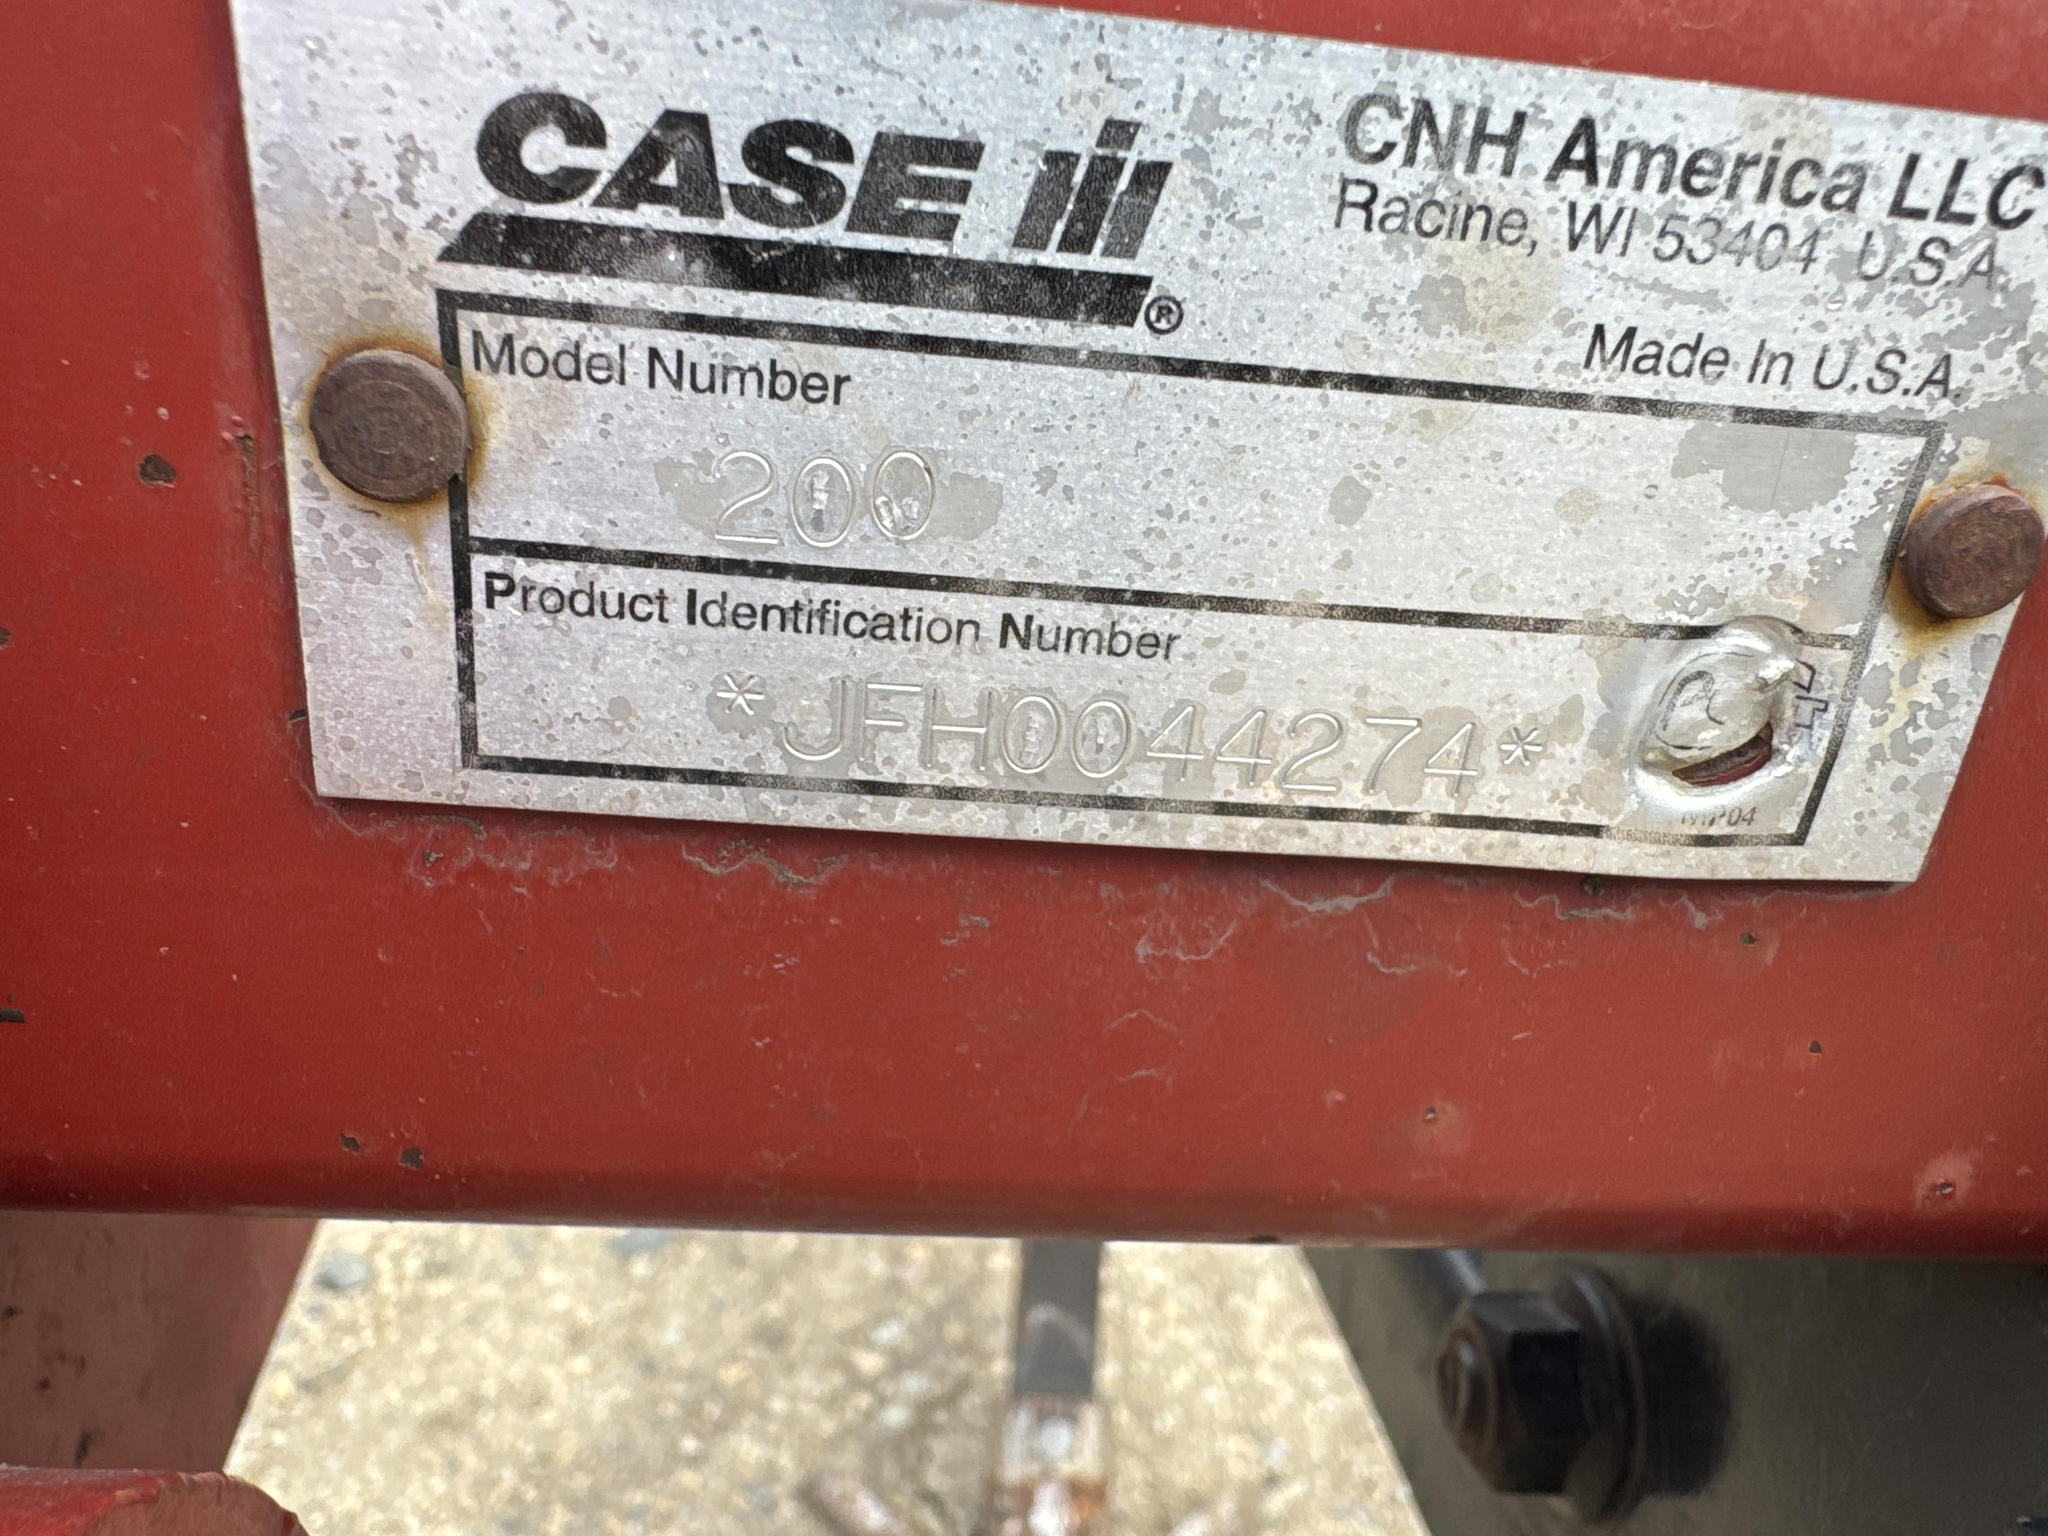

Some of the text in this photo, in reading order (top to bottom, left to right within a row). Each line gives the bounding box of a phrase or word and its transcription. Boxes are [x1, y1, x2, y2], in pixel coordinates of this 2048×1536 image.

[475, 92, 985, 242] CASE
[1344, 92, 2045, 231] CNH America LLC
[1333, 176, 1540, 258] Racine,
[1566, 202, 1637, 258] WI
[1652, 213, 1819, 275] 53404
[472, 330, 852, 407] Model Number
[1583, 324, 1962, 399] Made In U.S.A.
[713, 449, 938, 548] 200
[483, 572, 1182, 663] Product Identification Number
